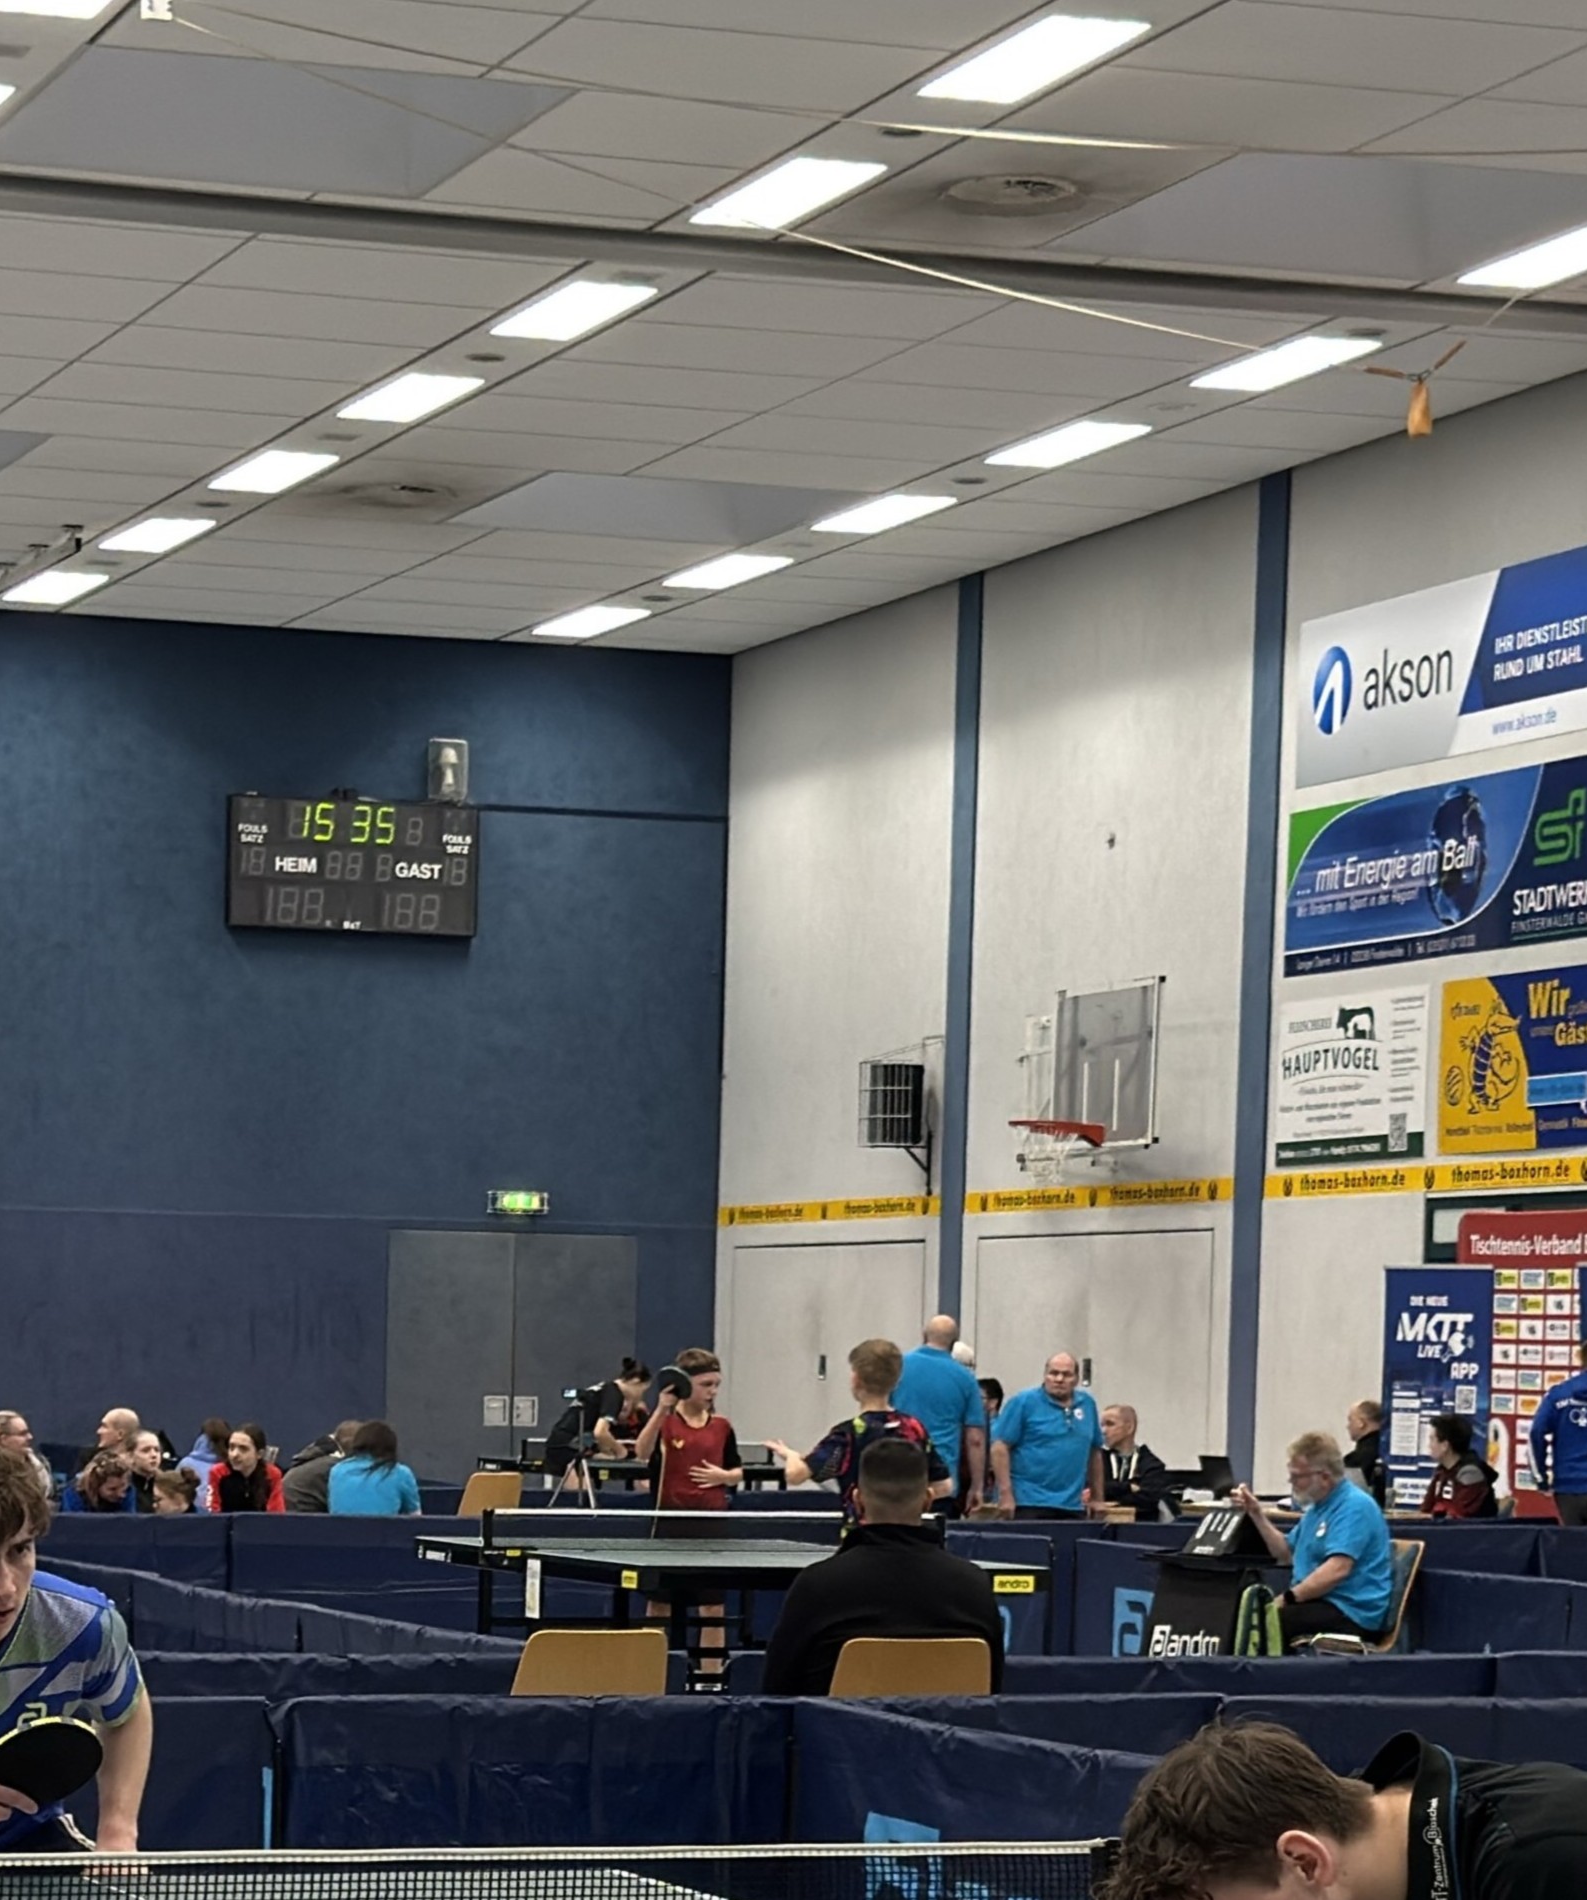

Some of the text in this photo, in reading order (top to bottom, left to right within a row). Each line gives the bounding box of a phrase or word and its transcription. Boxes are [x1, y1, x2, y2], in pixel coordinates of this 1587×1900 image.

[1494, 635, 1514, 655] IHR
[1493, 644, 1584, 682] RUND UM STAHL
[1363, 640, 1453, 711] akson
[1492, 707, 1557, 736] www.akson.de
[238, 823, 268, 835] FOULS
[301, 802, 396, 844] 15 35
[240, 833, 264, 844] SATZ
[442, 834, 472, 845] FOULS
[446, 845, 470, 855] SATZ
[274, 856, 318, 874] HEIM
[395, 862, 443, 880] GAST
[1315, 860, 1340, 893] mit
[1343, 848, 1407, 893] Energie
[1411, 850, 1438, 877] am
[1528, 979, 1571, 1019] Wir
[1282, 1047, 1380, 1081] HAUPTVOGEL
[1452, 1158, 1571, 1183] thomas-boxhorn.de
[1300, 1173, 1406, 1192] thomas-boxhorn.de
[1469, 1232, 1580, 1256] Tischtennis-Verband
[1417, 1344, 1444, 1359] LIVE
[1450, 1362, 1479, 1380] APP
